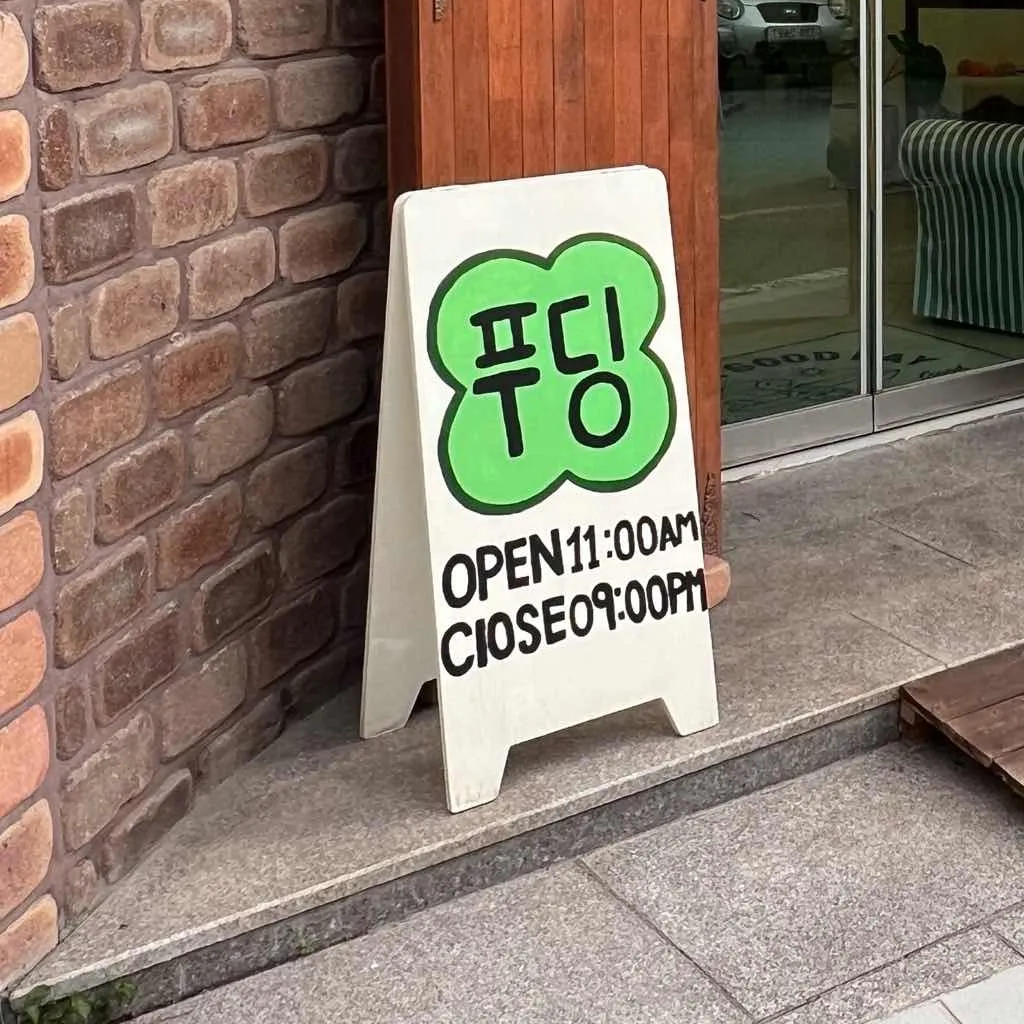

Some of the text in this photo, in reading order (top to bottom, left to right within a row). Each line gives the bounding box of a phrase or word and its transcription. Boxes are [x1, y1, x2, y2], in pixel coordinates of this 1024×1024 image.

[442, 511, 699, 608] OPEN 11:00AM
[569, 568, 708, 638] 09:00PM
